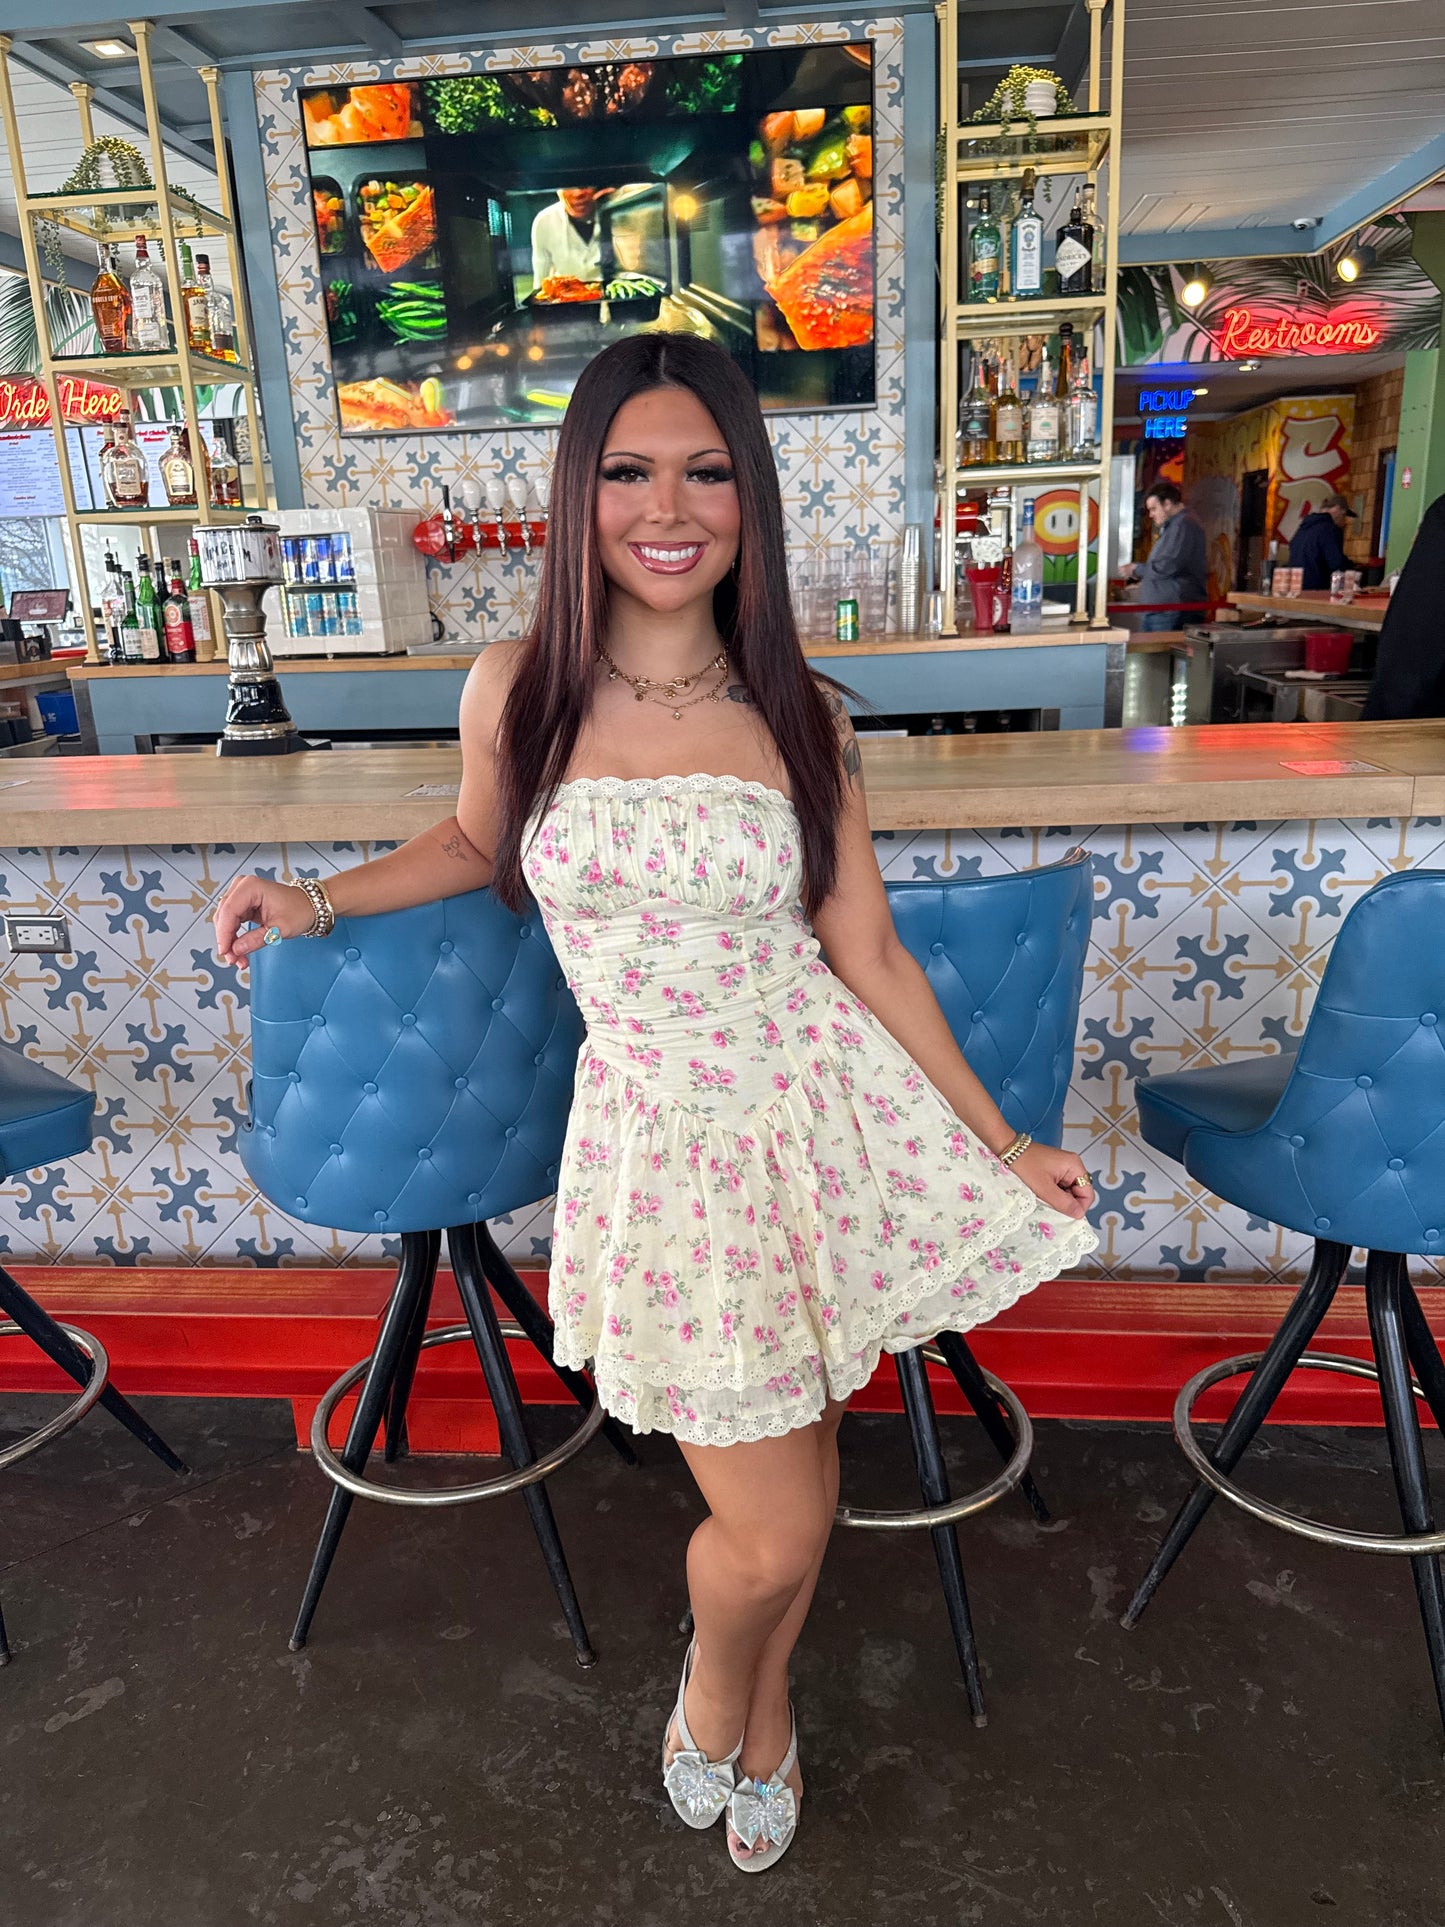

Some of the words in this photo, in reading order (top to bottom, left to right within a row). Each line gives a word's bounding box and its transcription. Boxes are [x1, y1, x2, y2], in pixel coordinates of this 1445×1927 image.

[1221, 308, 1380, 351] Restrooms
[0, 381, 49, 420] Orde
[63, 379, 122, 417] Here
[1139, 389, 1196, 412] PICKUP
[1145, 416, 1188, 439] HERE
[220, 541, 253, 562] BEM
